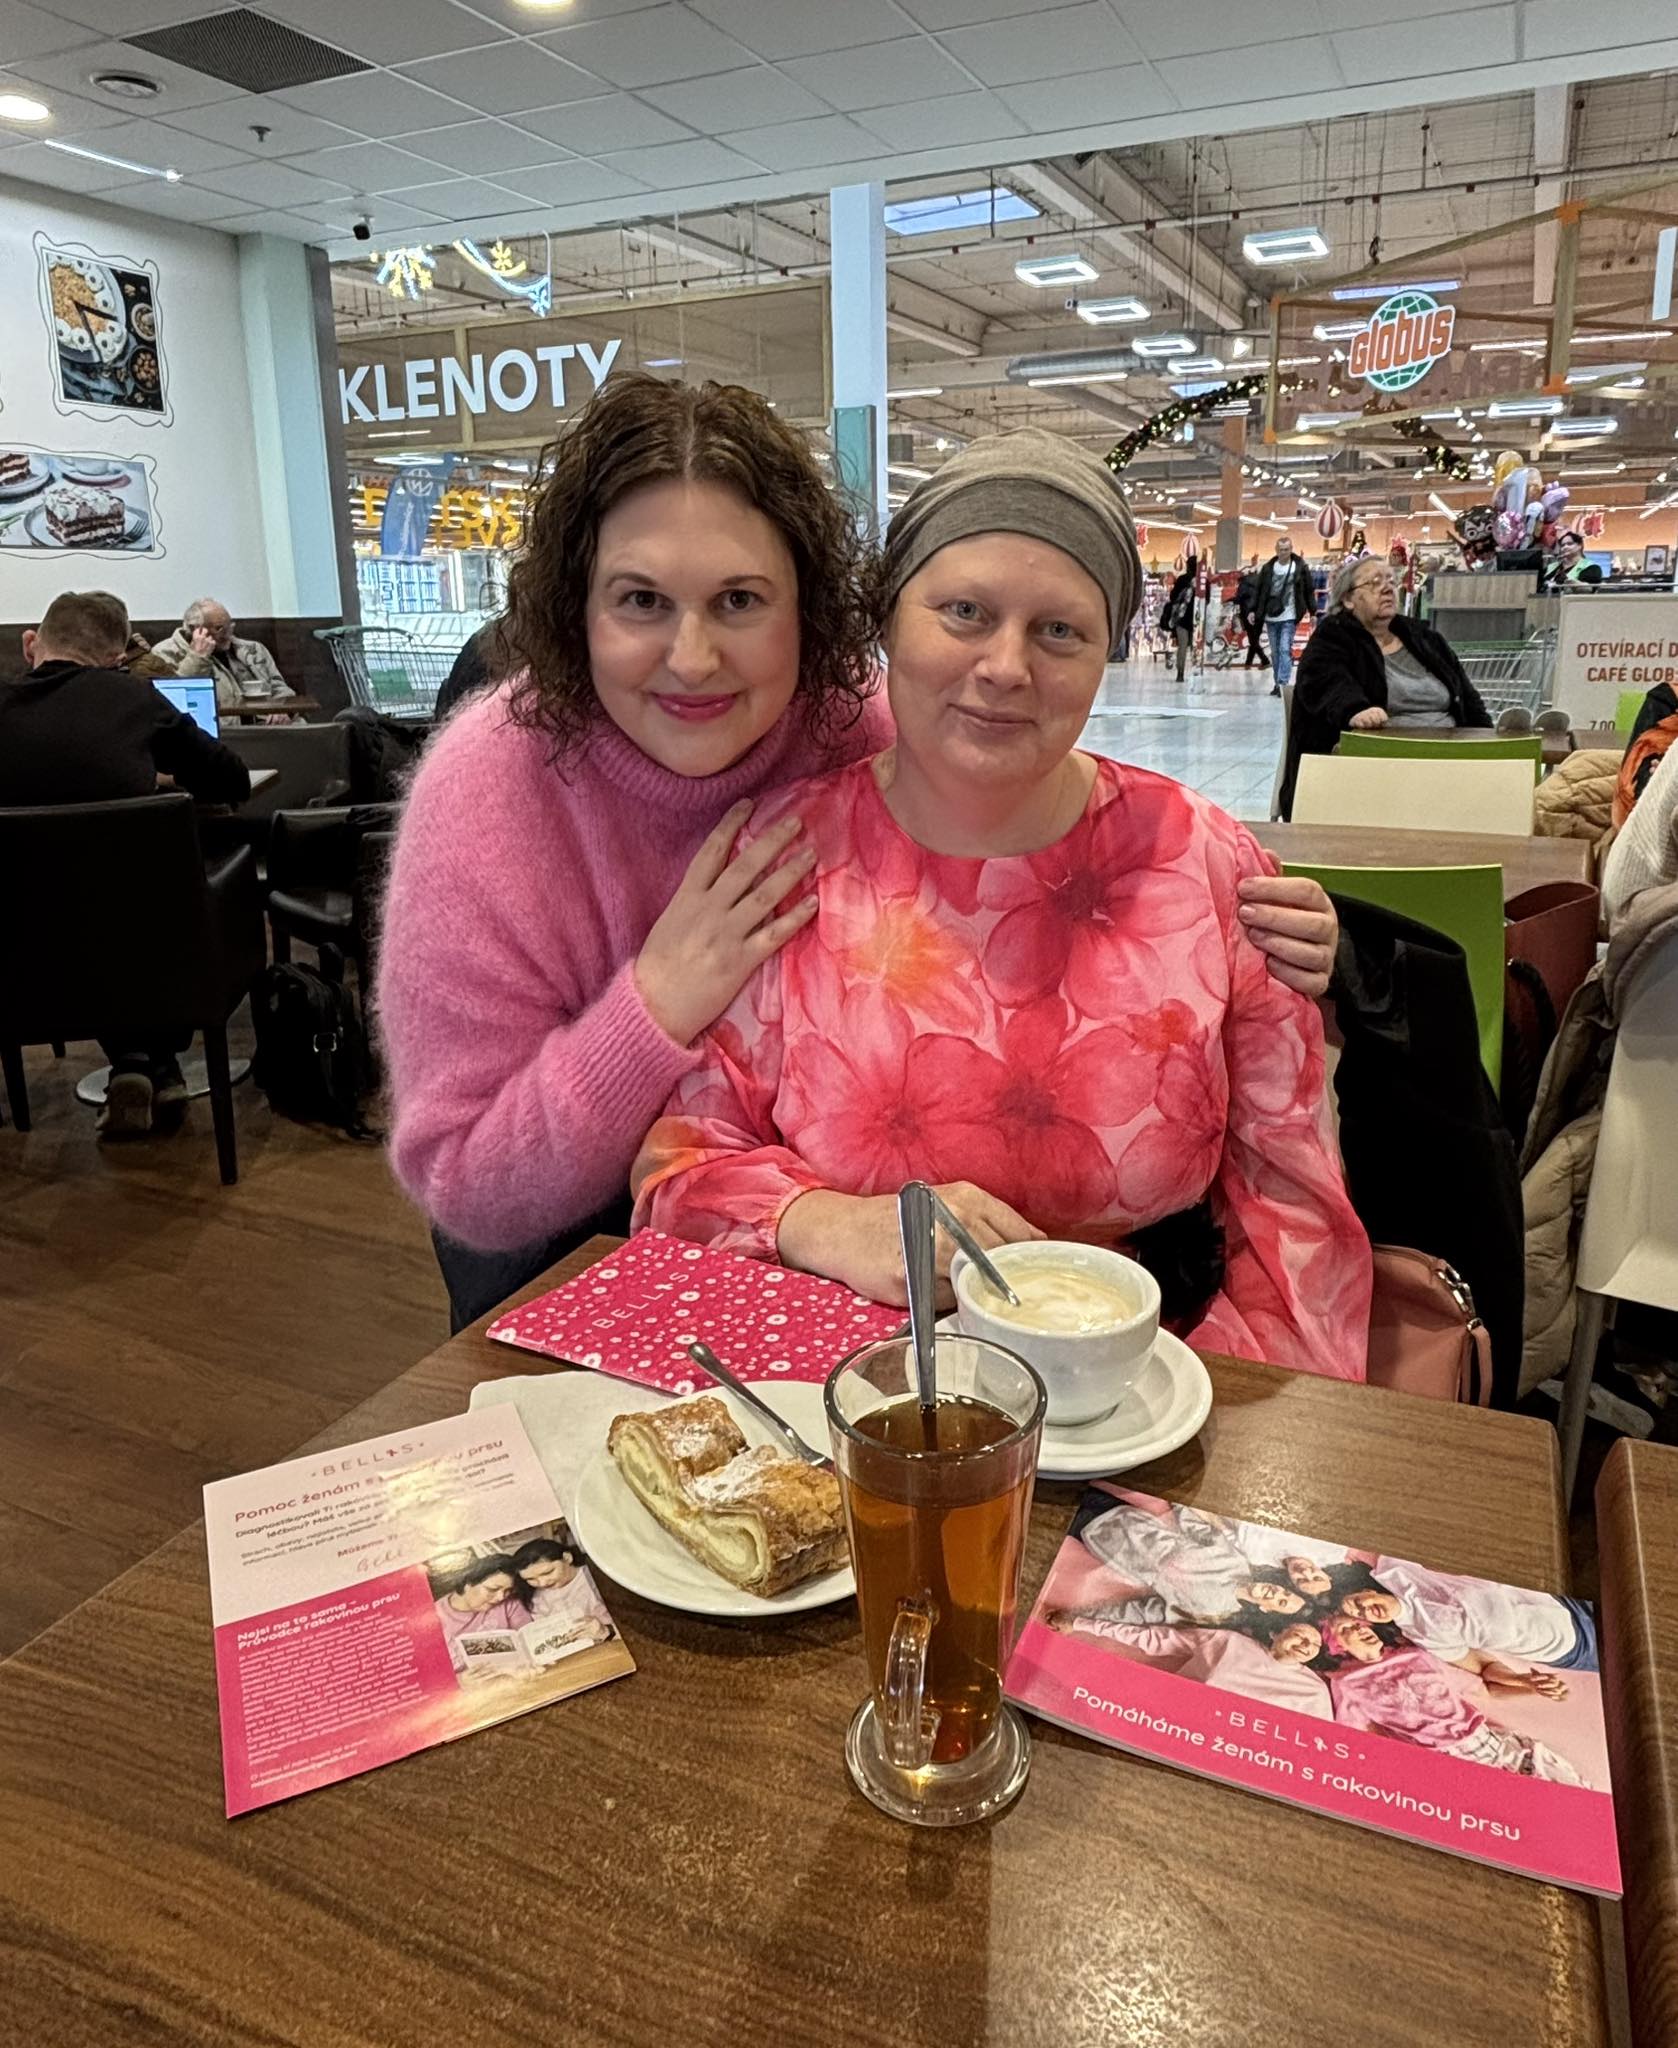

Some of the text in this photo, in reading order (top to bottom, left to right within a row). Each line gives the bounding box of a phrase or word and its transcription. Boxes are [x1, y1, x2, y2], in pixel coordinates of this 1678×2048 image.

[338, 339, 622, 425] KLENOTY
[1576, 637, 1665, 659] OTEVÍRACÍ
[1587, 664, 1678, 682] CAFÉ GLOB
[1589, 720, 1616, 731] 700
[235, 1499, 297, 1523] Pomoc
[302, 1481, 361, 1504] ženám
[304, 1603, 369, 1631] rakovinou
[371, 1592, 401, 1610] prsu
[1072, 1685, 1522, 1842] Pomáháme ženám s rakovinou prsu
